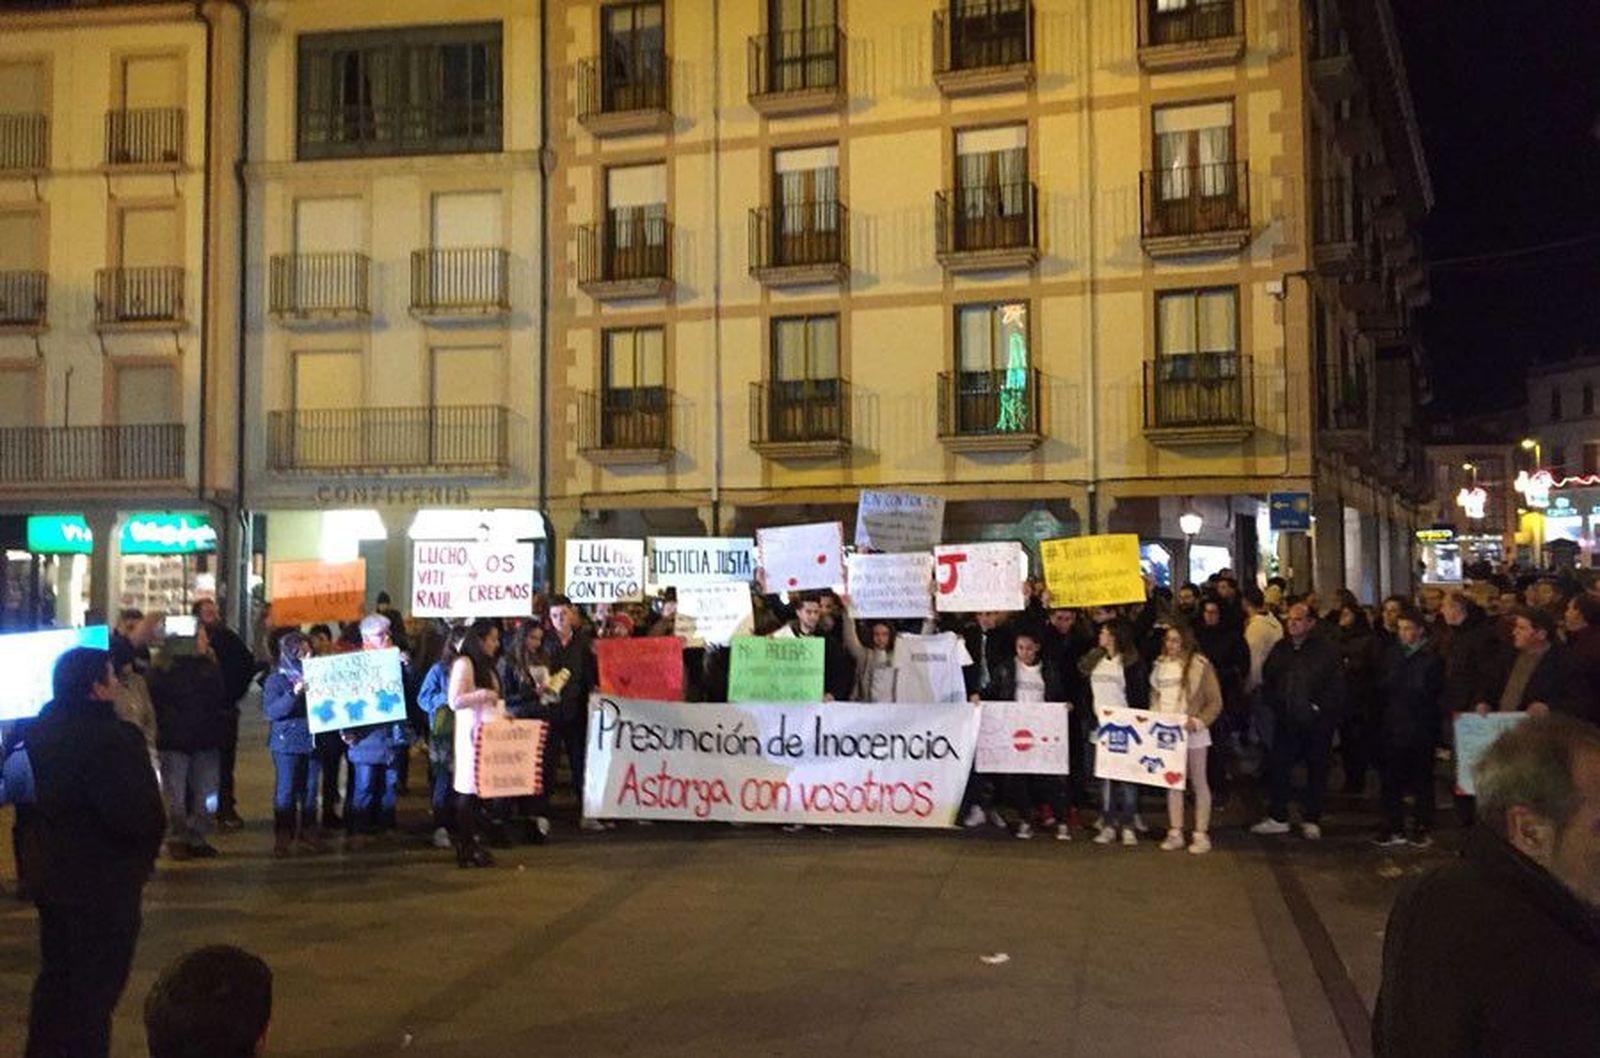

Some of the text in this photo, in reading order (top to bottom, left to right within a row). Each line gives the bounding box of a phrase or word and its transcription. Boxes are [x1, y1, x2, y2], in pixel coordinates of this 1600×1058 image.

[418, 547, 468, 566] LUCHO
[486, 554, 515, 573] OS
[652, 549, 751, 576] JUSTICIA JUSTA
[417, 570, 445, 585] VITI
[469, 584, 530, 603] CREEMOS
[567, 581, 639, 599] CONTIGO
[598, 698, 961, 760] Presunción de Inocencia
[617, 761, 935, 818] Astorga con vosotros
